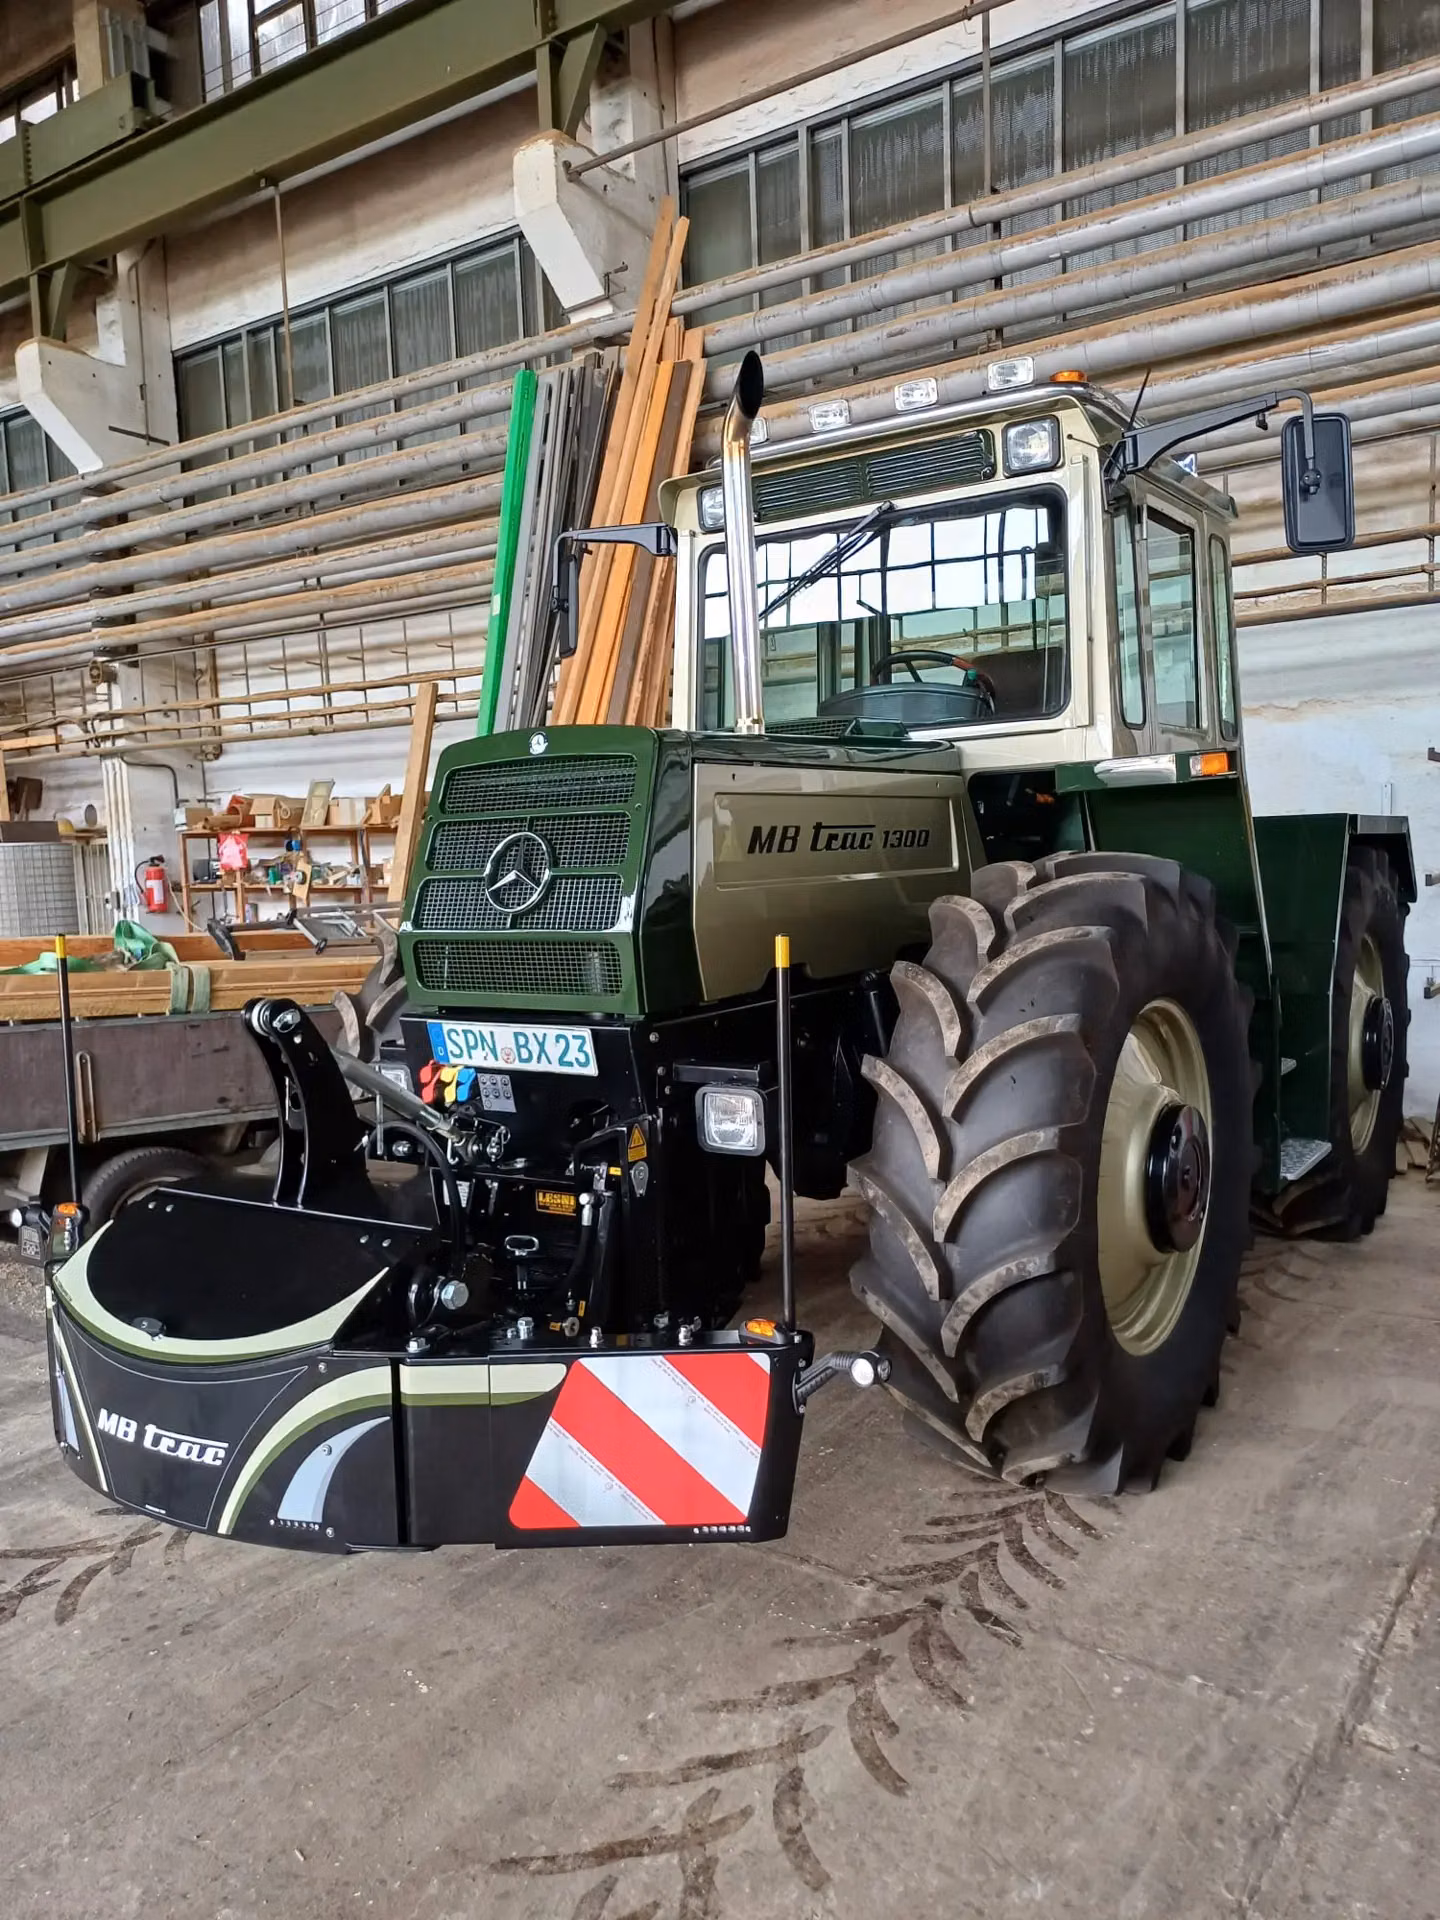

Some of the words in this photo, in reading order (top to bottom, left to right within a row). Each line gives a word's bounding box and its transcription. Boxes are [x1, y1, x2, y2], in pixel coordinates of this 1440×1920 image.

[747, 825, 801, 854] MB
[809, 821, 876, 851] trac
[882, 829, 930, 849] 1300
[446, 1028, 499, 1061] SPN
[513, 1031, 552, 1065] BX
[554, 1033, 591, 1068] 23
[97, 1407, 138, 1443] MB
[142, 1423, 229, 1466] trac
